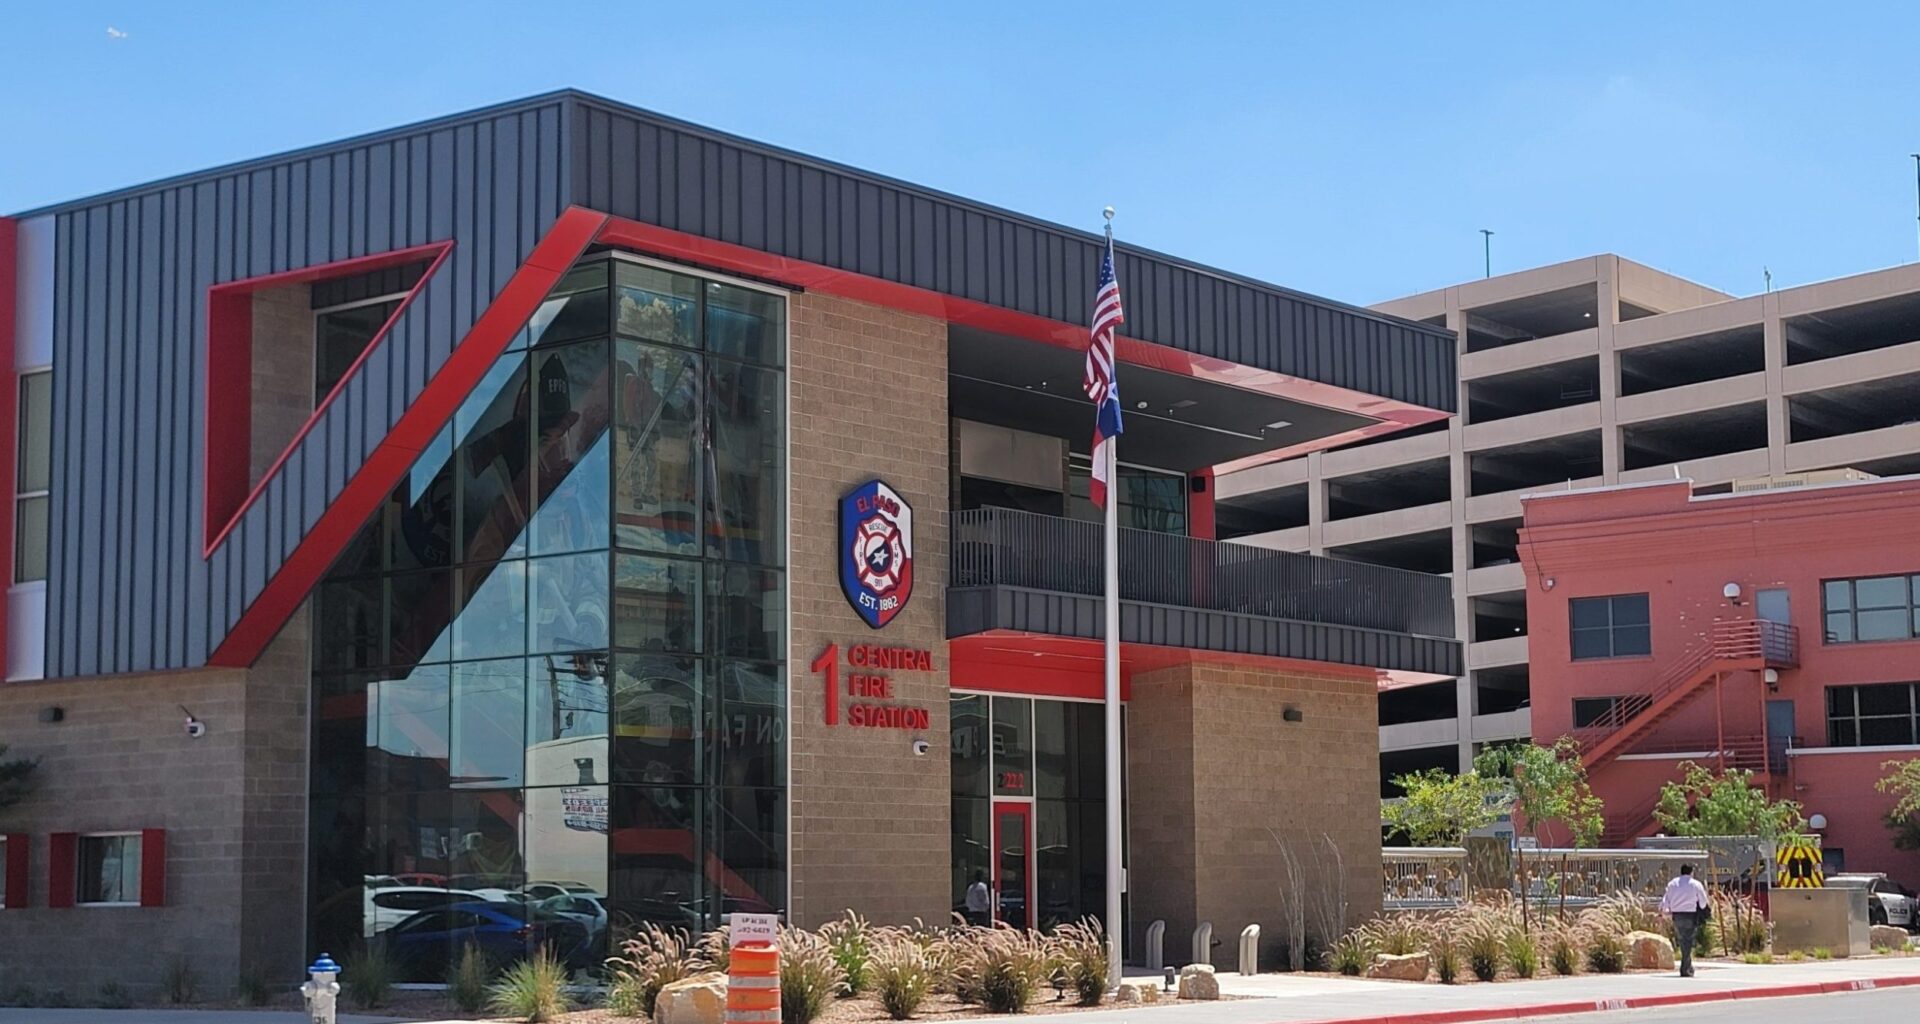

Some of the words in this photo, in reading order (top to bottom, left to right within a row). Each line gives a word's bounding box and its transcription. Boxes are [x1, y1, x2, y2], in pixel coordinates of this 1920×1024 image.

[856, 496, 871, 513] EL
[873, 494, 901, 518] PASO
[868, 522, 888, 534] RESCUE
[874, 578, 884, 587] 911
[859, 592, 878, 610] EST.
[879, 595, 899, 611] 1882
[847, 643, 938, 672] CENTRAL
[811, 641, 839, 726] 1
[848, 673, 895, 699] FIRE
[848, 703, 930, 730] STATION
